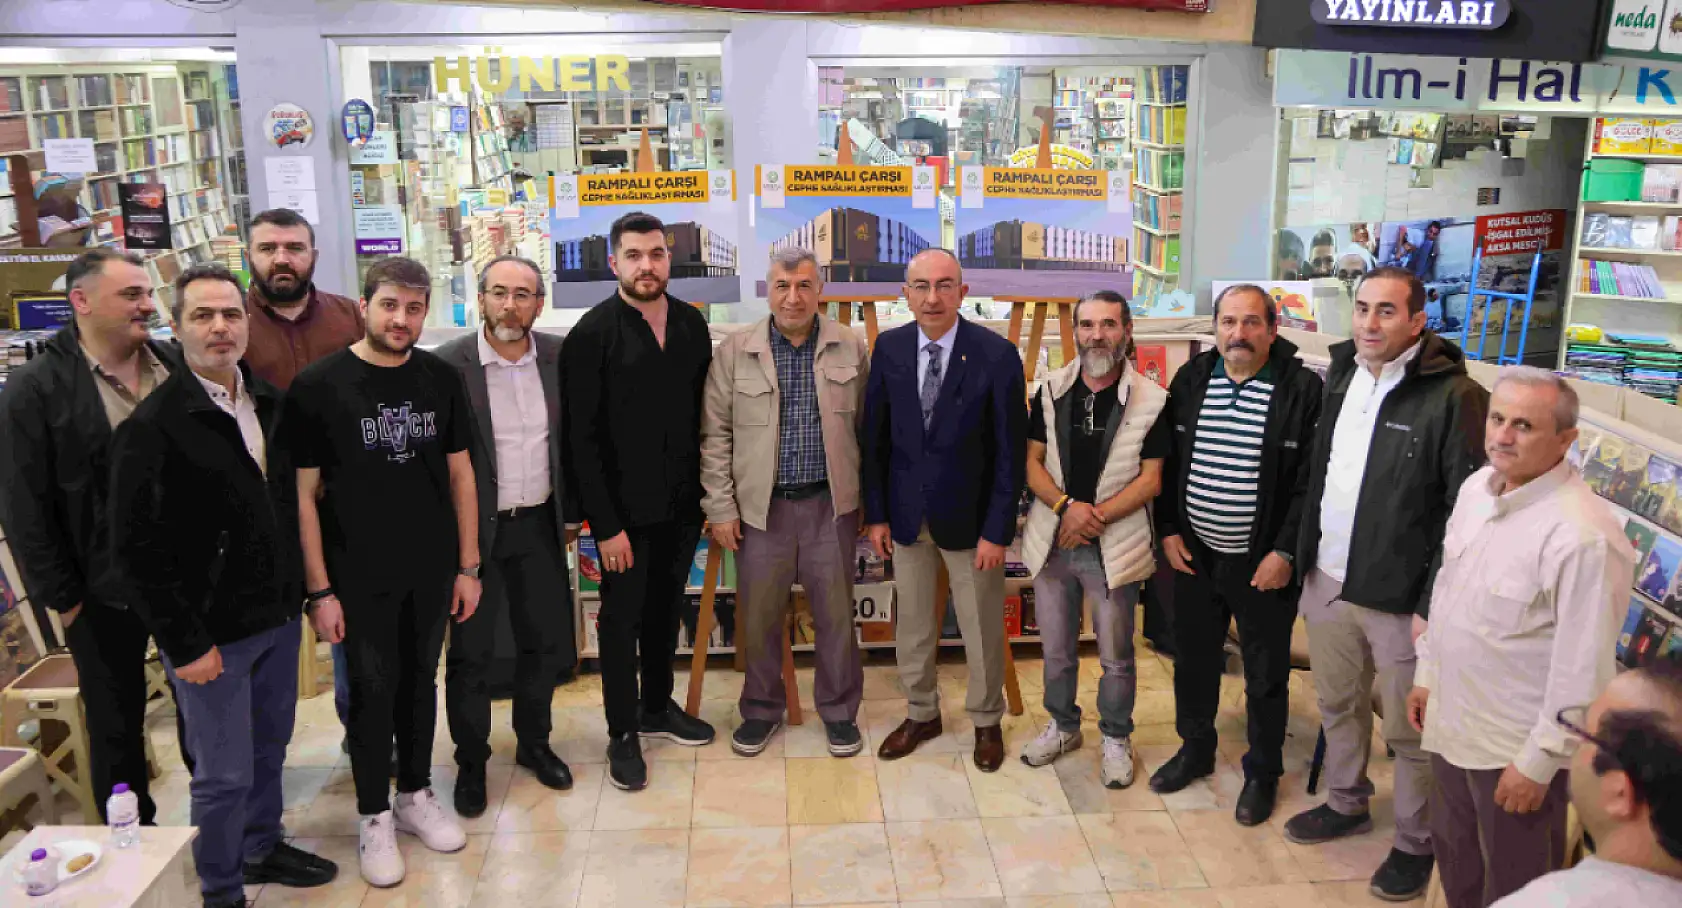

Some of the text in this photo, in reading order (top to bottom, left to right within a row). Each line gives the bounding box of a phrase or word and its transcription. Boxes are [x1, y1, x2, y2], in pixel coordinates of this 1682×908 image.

[1326, 0, 1495, 25] YAYINLARI
[434, 46, 631, 93] HÜNER
[793, 170, 902, 183] RAMPALI ÇARŞI
[993, 171, 1098, 187] RAMPALI ÇARŞI
[587, 176, 697, 191] RAMPALI ÇARŞI
[787, 185, 819, 193] CEPHE
[986, 185, 1016, 194] CEPHE
[581, 193, 614, 202] CEPHE
[1487, 216, 1521, 228] KUTSAL
